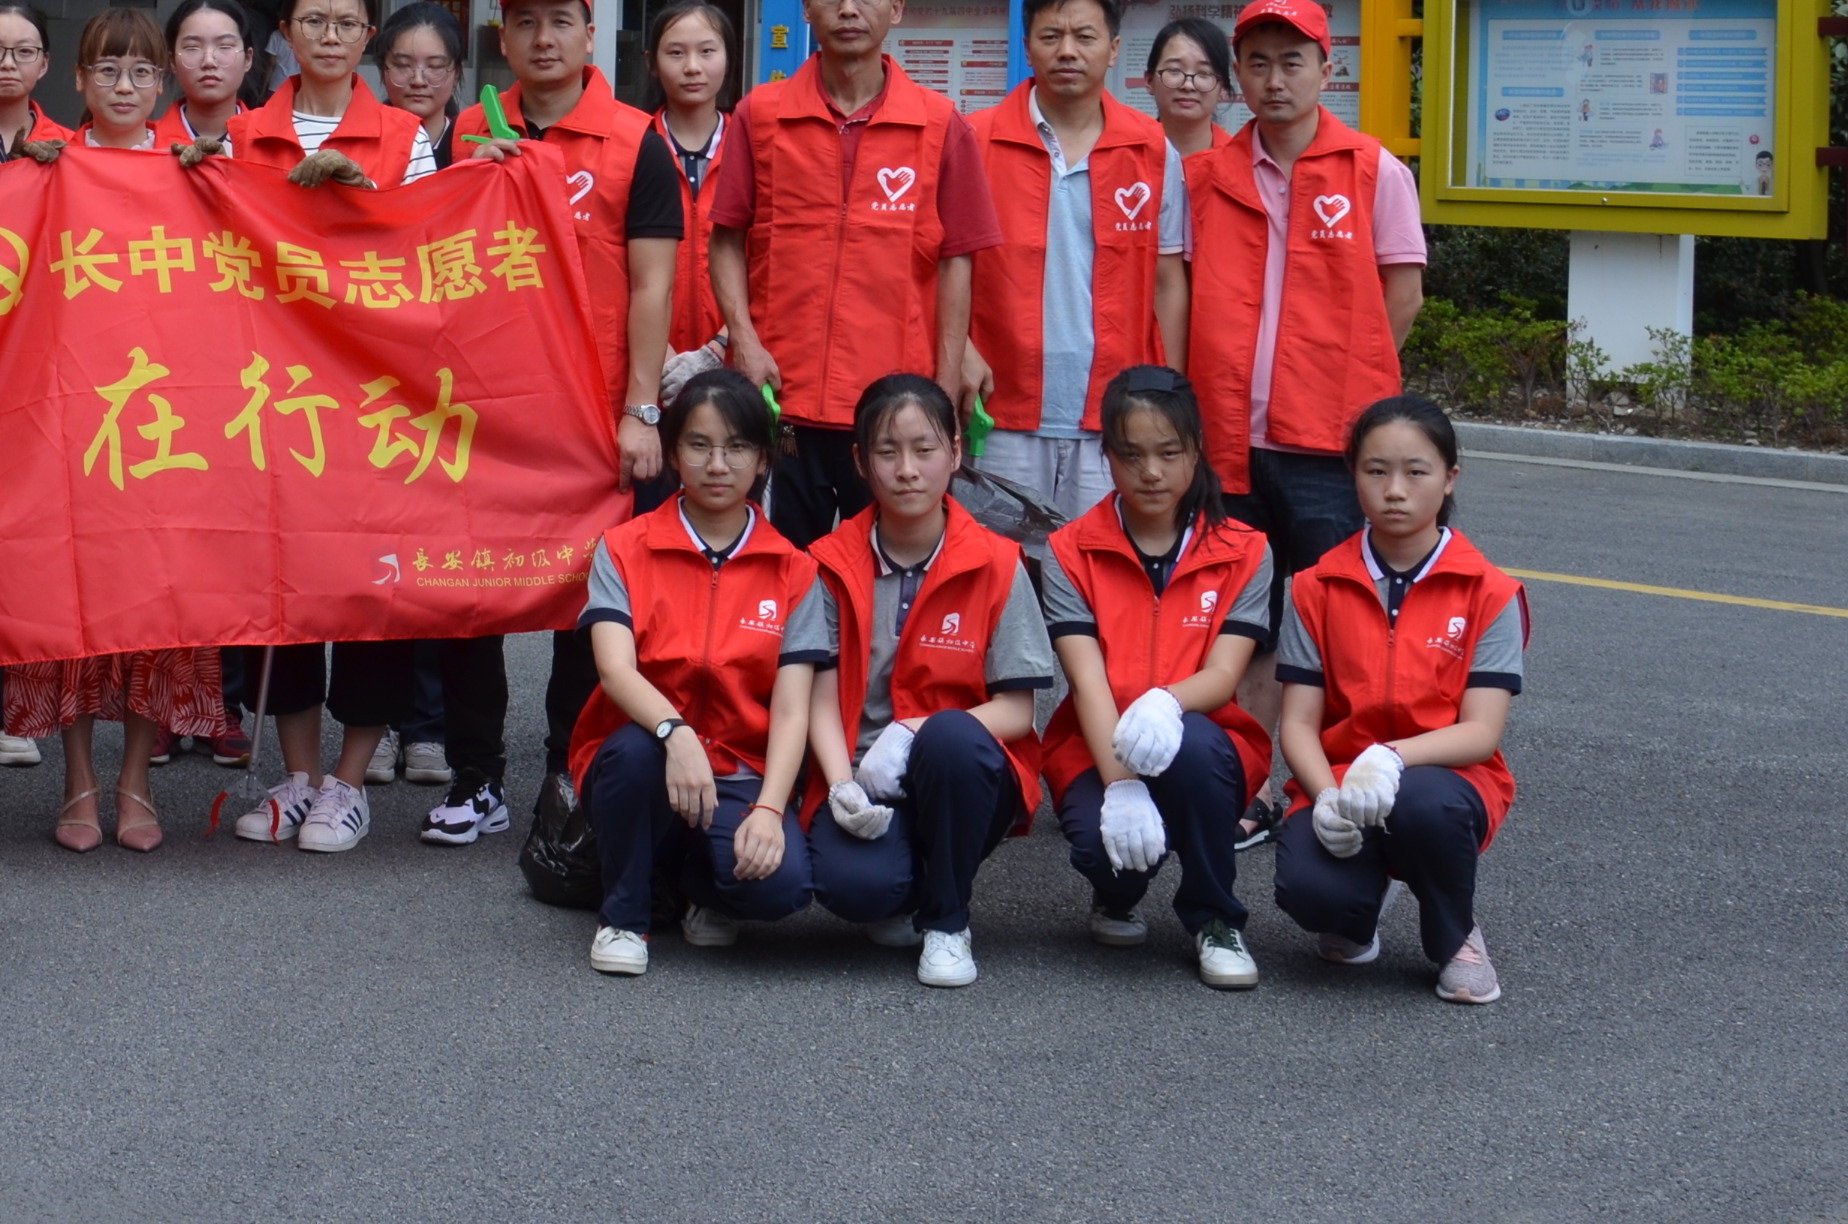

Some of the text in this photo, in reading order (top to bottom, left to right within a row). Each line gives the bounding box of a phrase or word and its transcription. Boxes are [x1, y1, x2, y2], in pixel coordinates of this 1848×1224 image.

[50, 219, 547, 310] 长中党员志愿者
[83, 346, 480, 492] 在行动
[416, 572, 589, 588] CHANGAN JUNIOR MIDDLE SCHO
